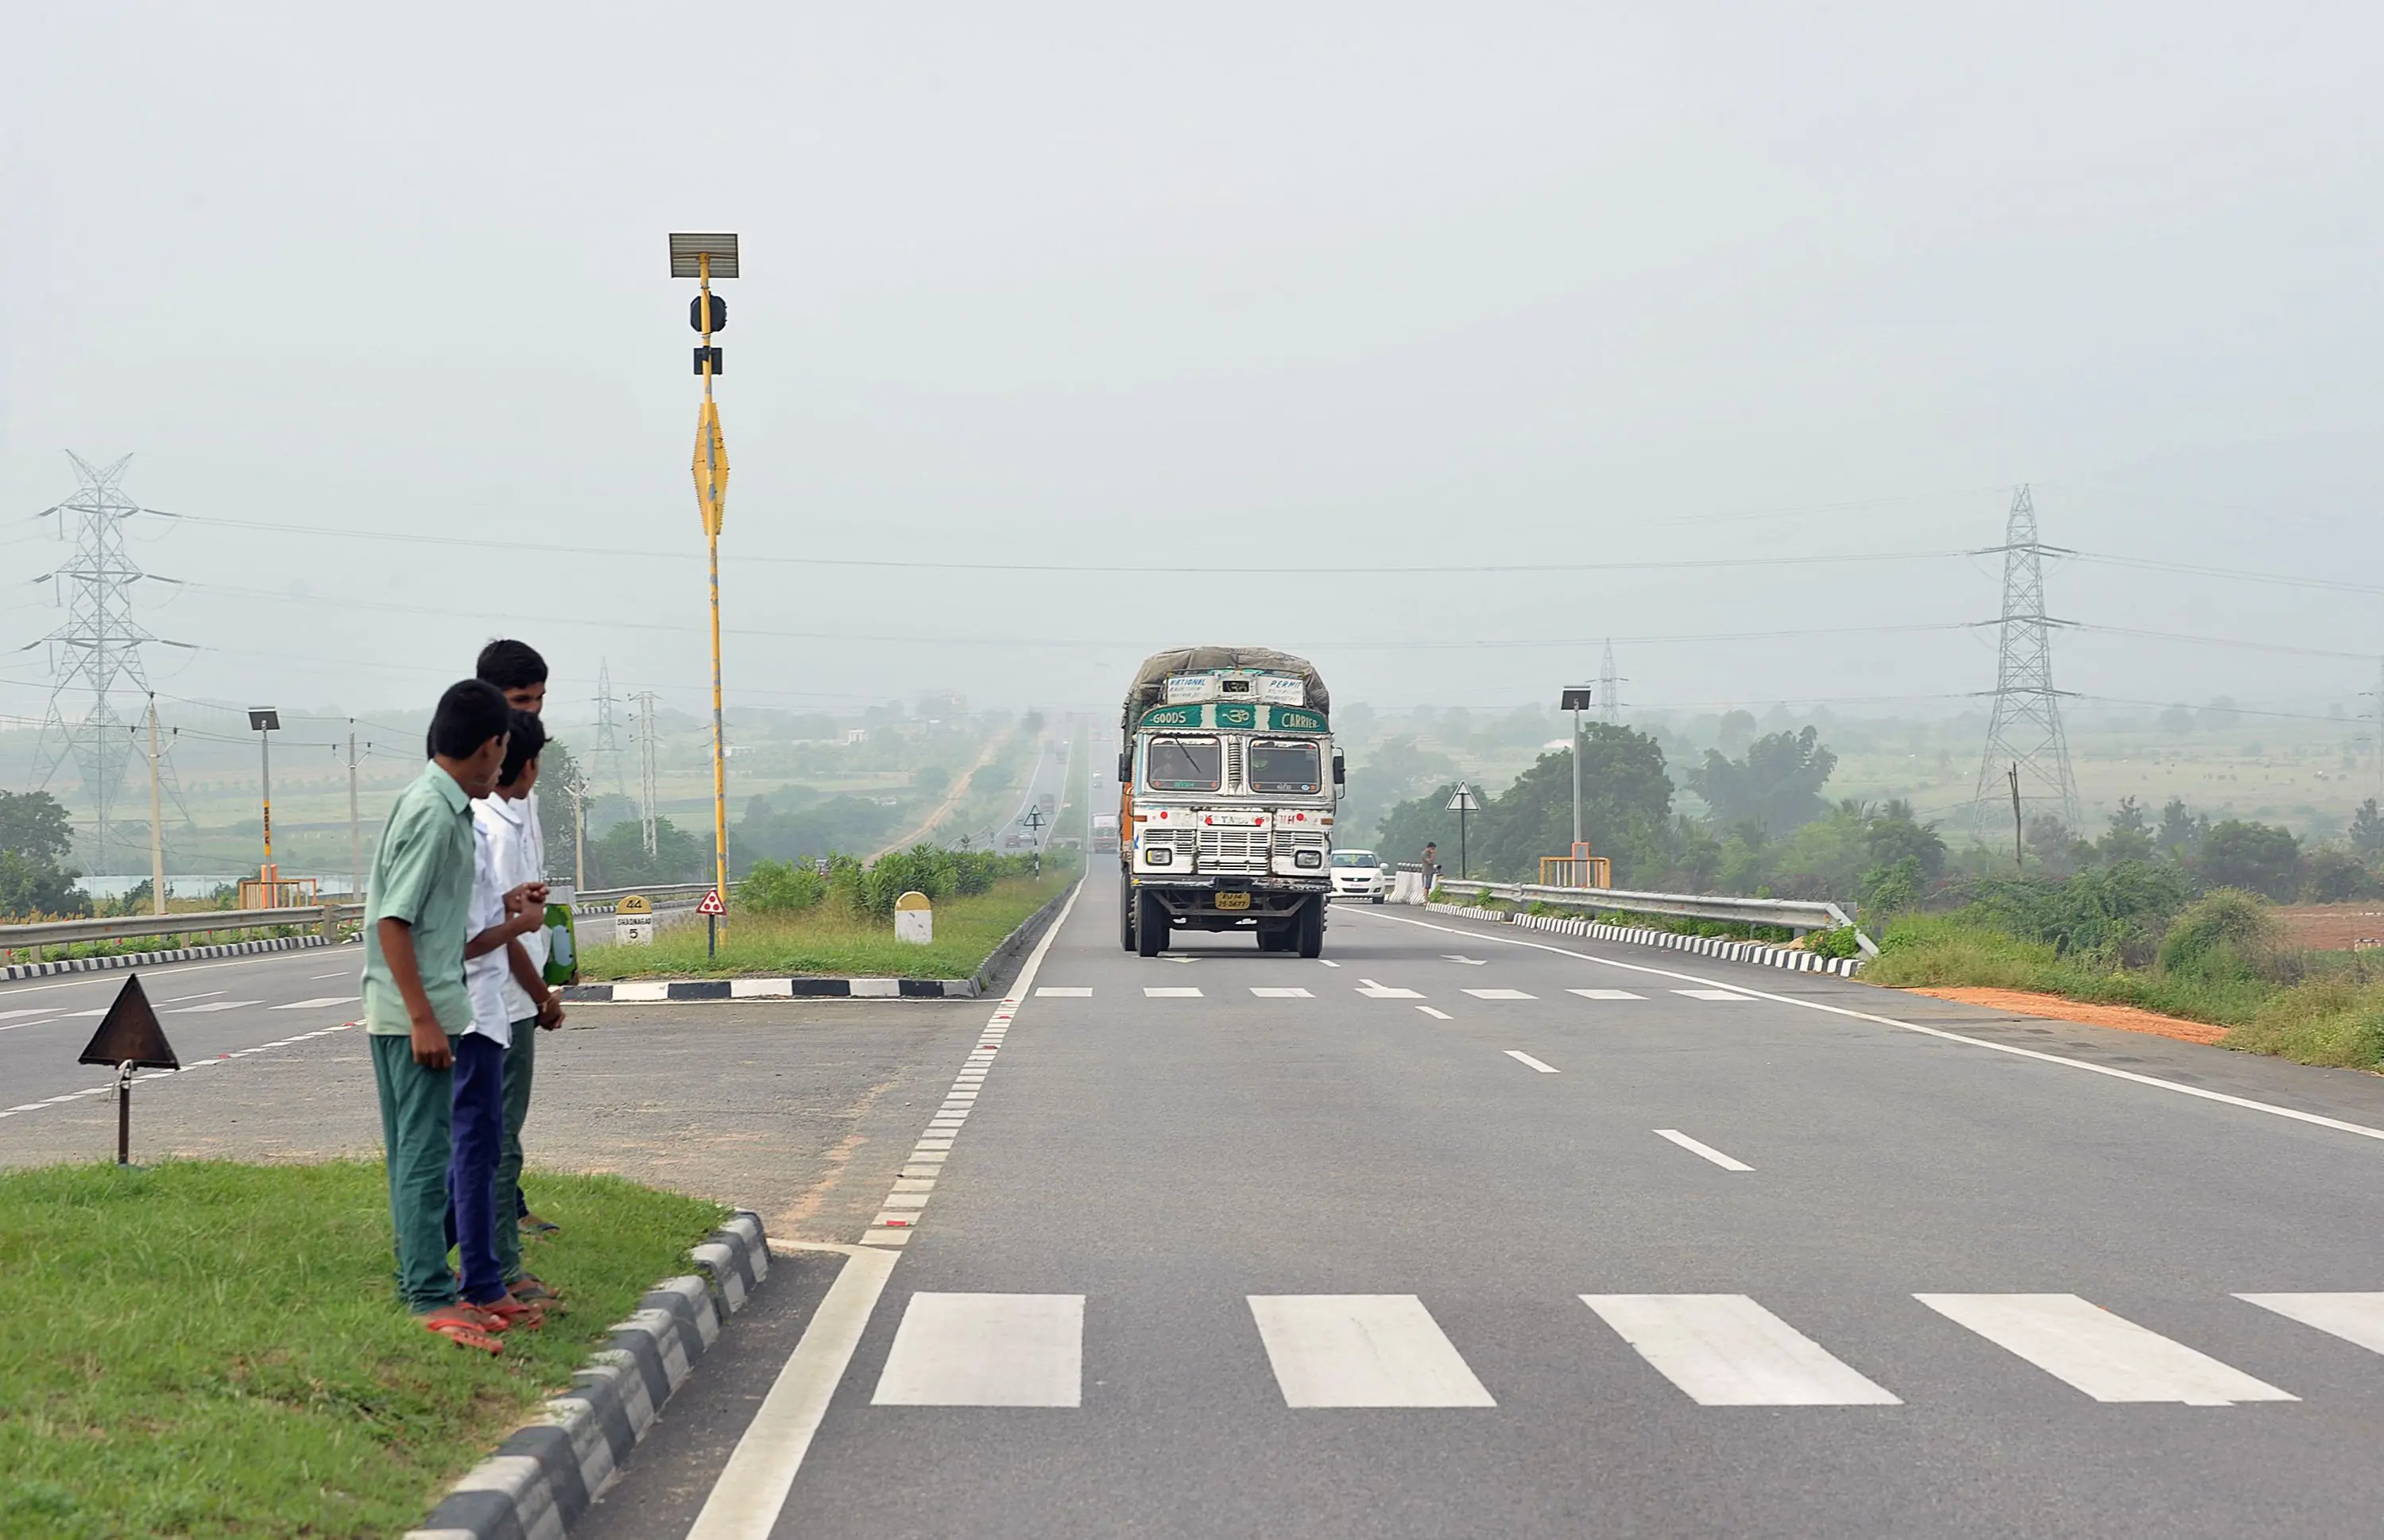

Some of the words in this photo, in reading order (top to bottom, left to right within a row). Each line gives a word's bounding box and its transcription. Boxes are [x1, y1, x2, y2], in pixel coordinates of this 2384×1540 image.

[1170, 678, 1206, 687] NATIONAL
[1269, 679, 1302, 689] PERMIT
[1152, 710, 1186, 724] GOODS
[1281, 712, 1318, 729] CARRIER
[626, 900, 642, 908] 44
[629, 928, 638, 938] 5
